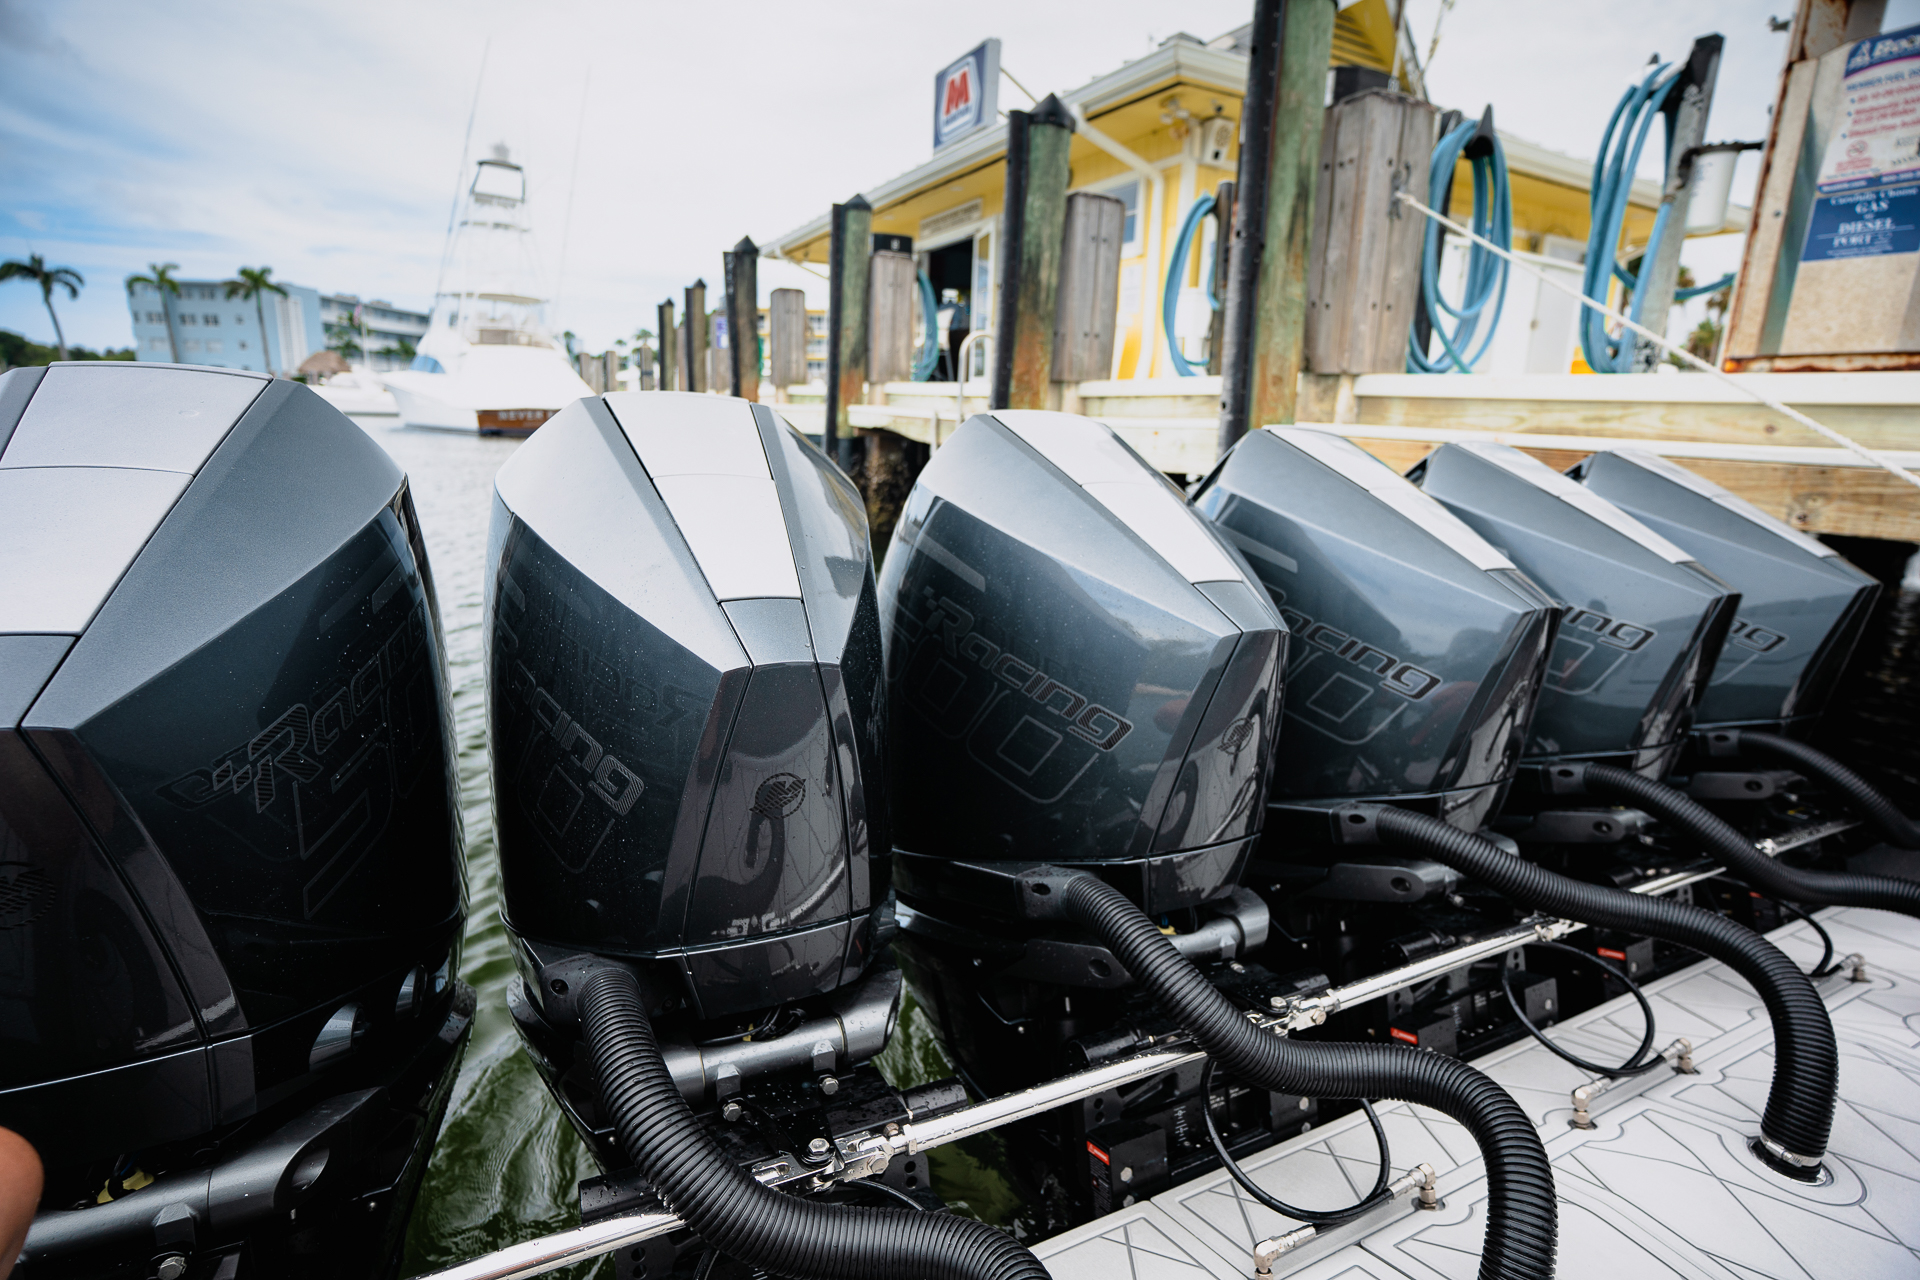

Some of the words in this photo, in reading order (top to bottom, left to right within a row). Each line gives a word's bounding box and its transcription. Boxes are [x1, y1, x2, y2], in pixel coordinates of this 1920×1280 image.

[944, 70, 969, 117] M
[1838, 217, 1895, 235] DIESEL
[1854, 199, 1889, 215] GAS
[937, 596, 1135, 752] Racing
[1264, 600, 1444, 703] acing
